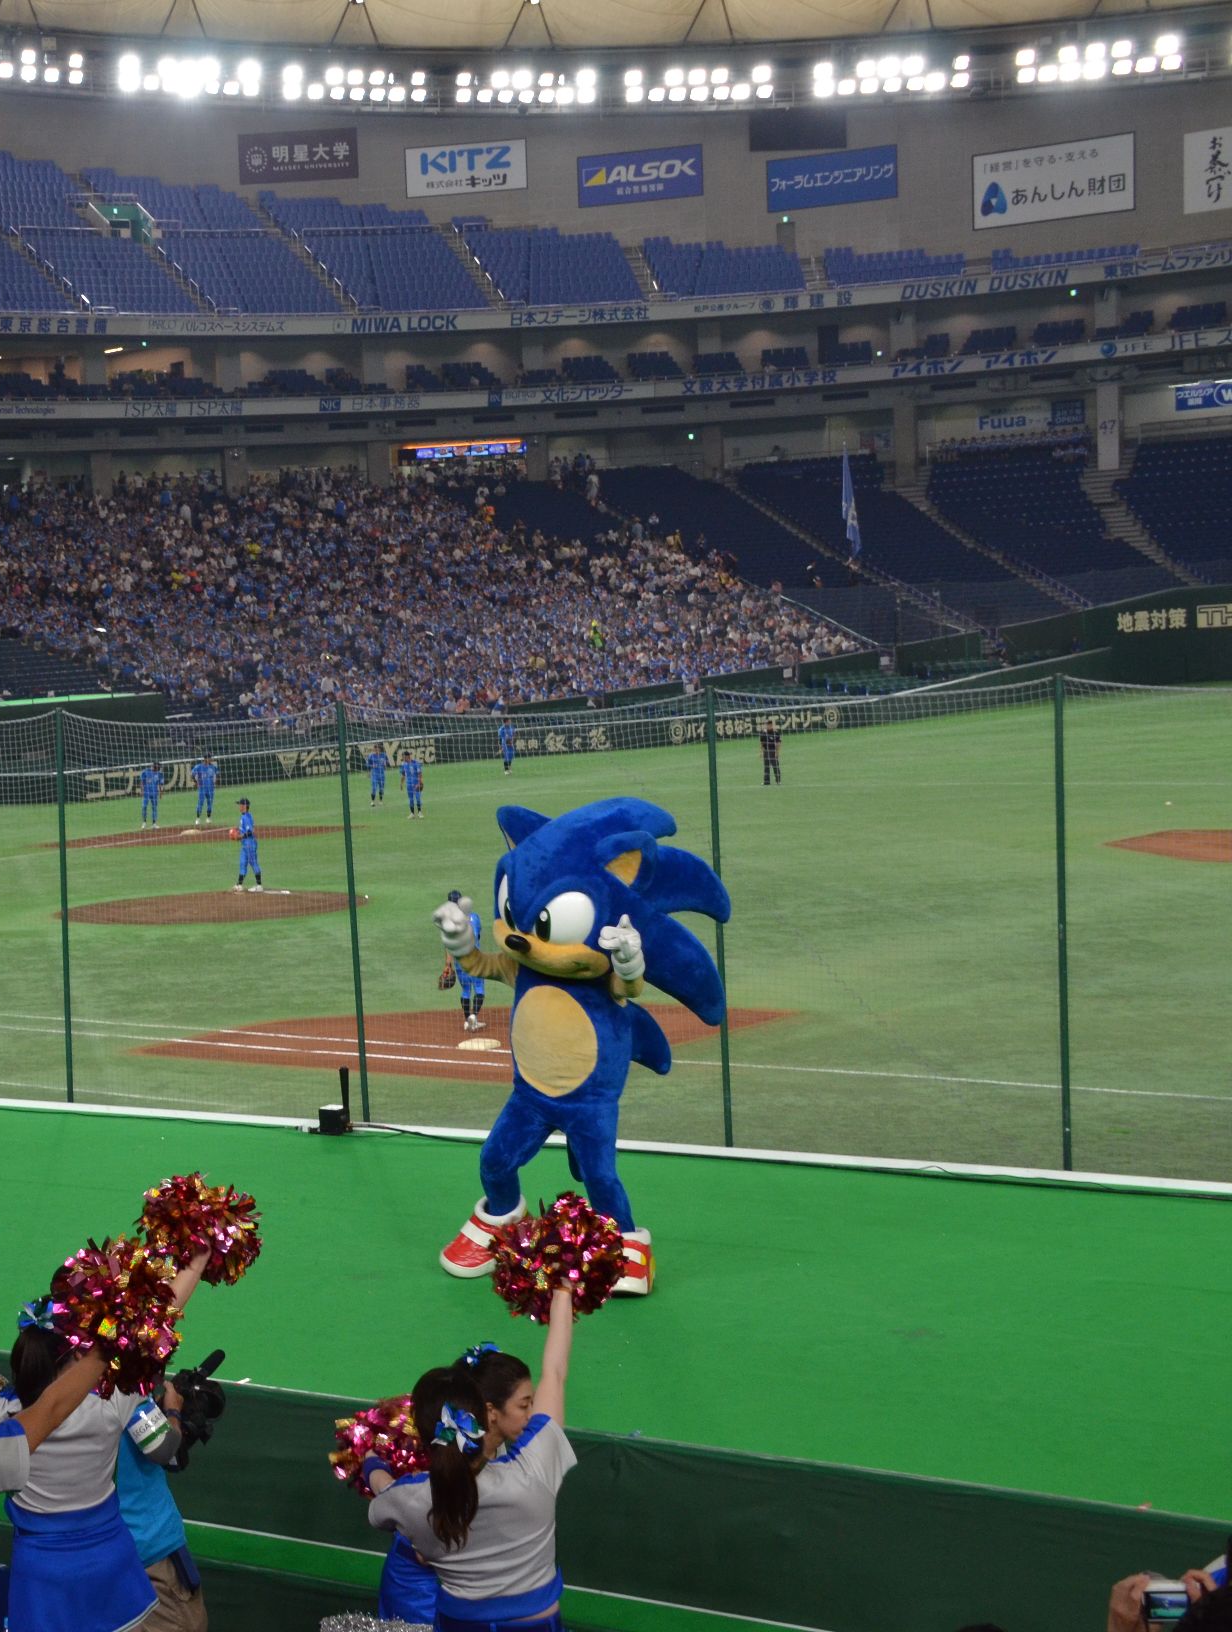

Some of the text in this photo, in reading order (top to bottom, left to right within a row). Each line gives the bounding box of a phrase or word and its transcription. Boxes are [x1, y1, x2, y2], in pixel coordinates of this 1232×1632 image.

[272, 142, 349, 163] 明星大学
[420, 146, 511, 176] KITZ
[606, 158, 696, 184] ALSOK
[771, 161, 895, 193] フォーラムエンジニアリング
[1011, 173, 1126, 206] あんしん財団
[0, 316, 109, 333] 東京総合警備
[352, 315, 458, 333] MIWA LOCK
[510, 306, 650, 326] 日本ステージ株式会社
[320, 399, 341, 410] NJC
[978, 415, 1026, 431] Fuua
[1099, 419, 1116, 434] 47
[1117, 608, 1187, 633] 地震対策
[687, 718, 753, 739] バイするなら
